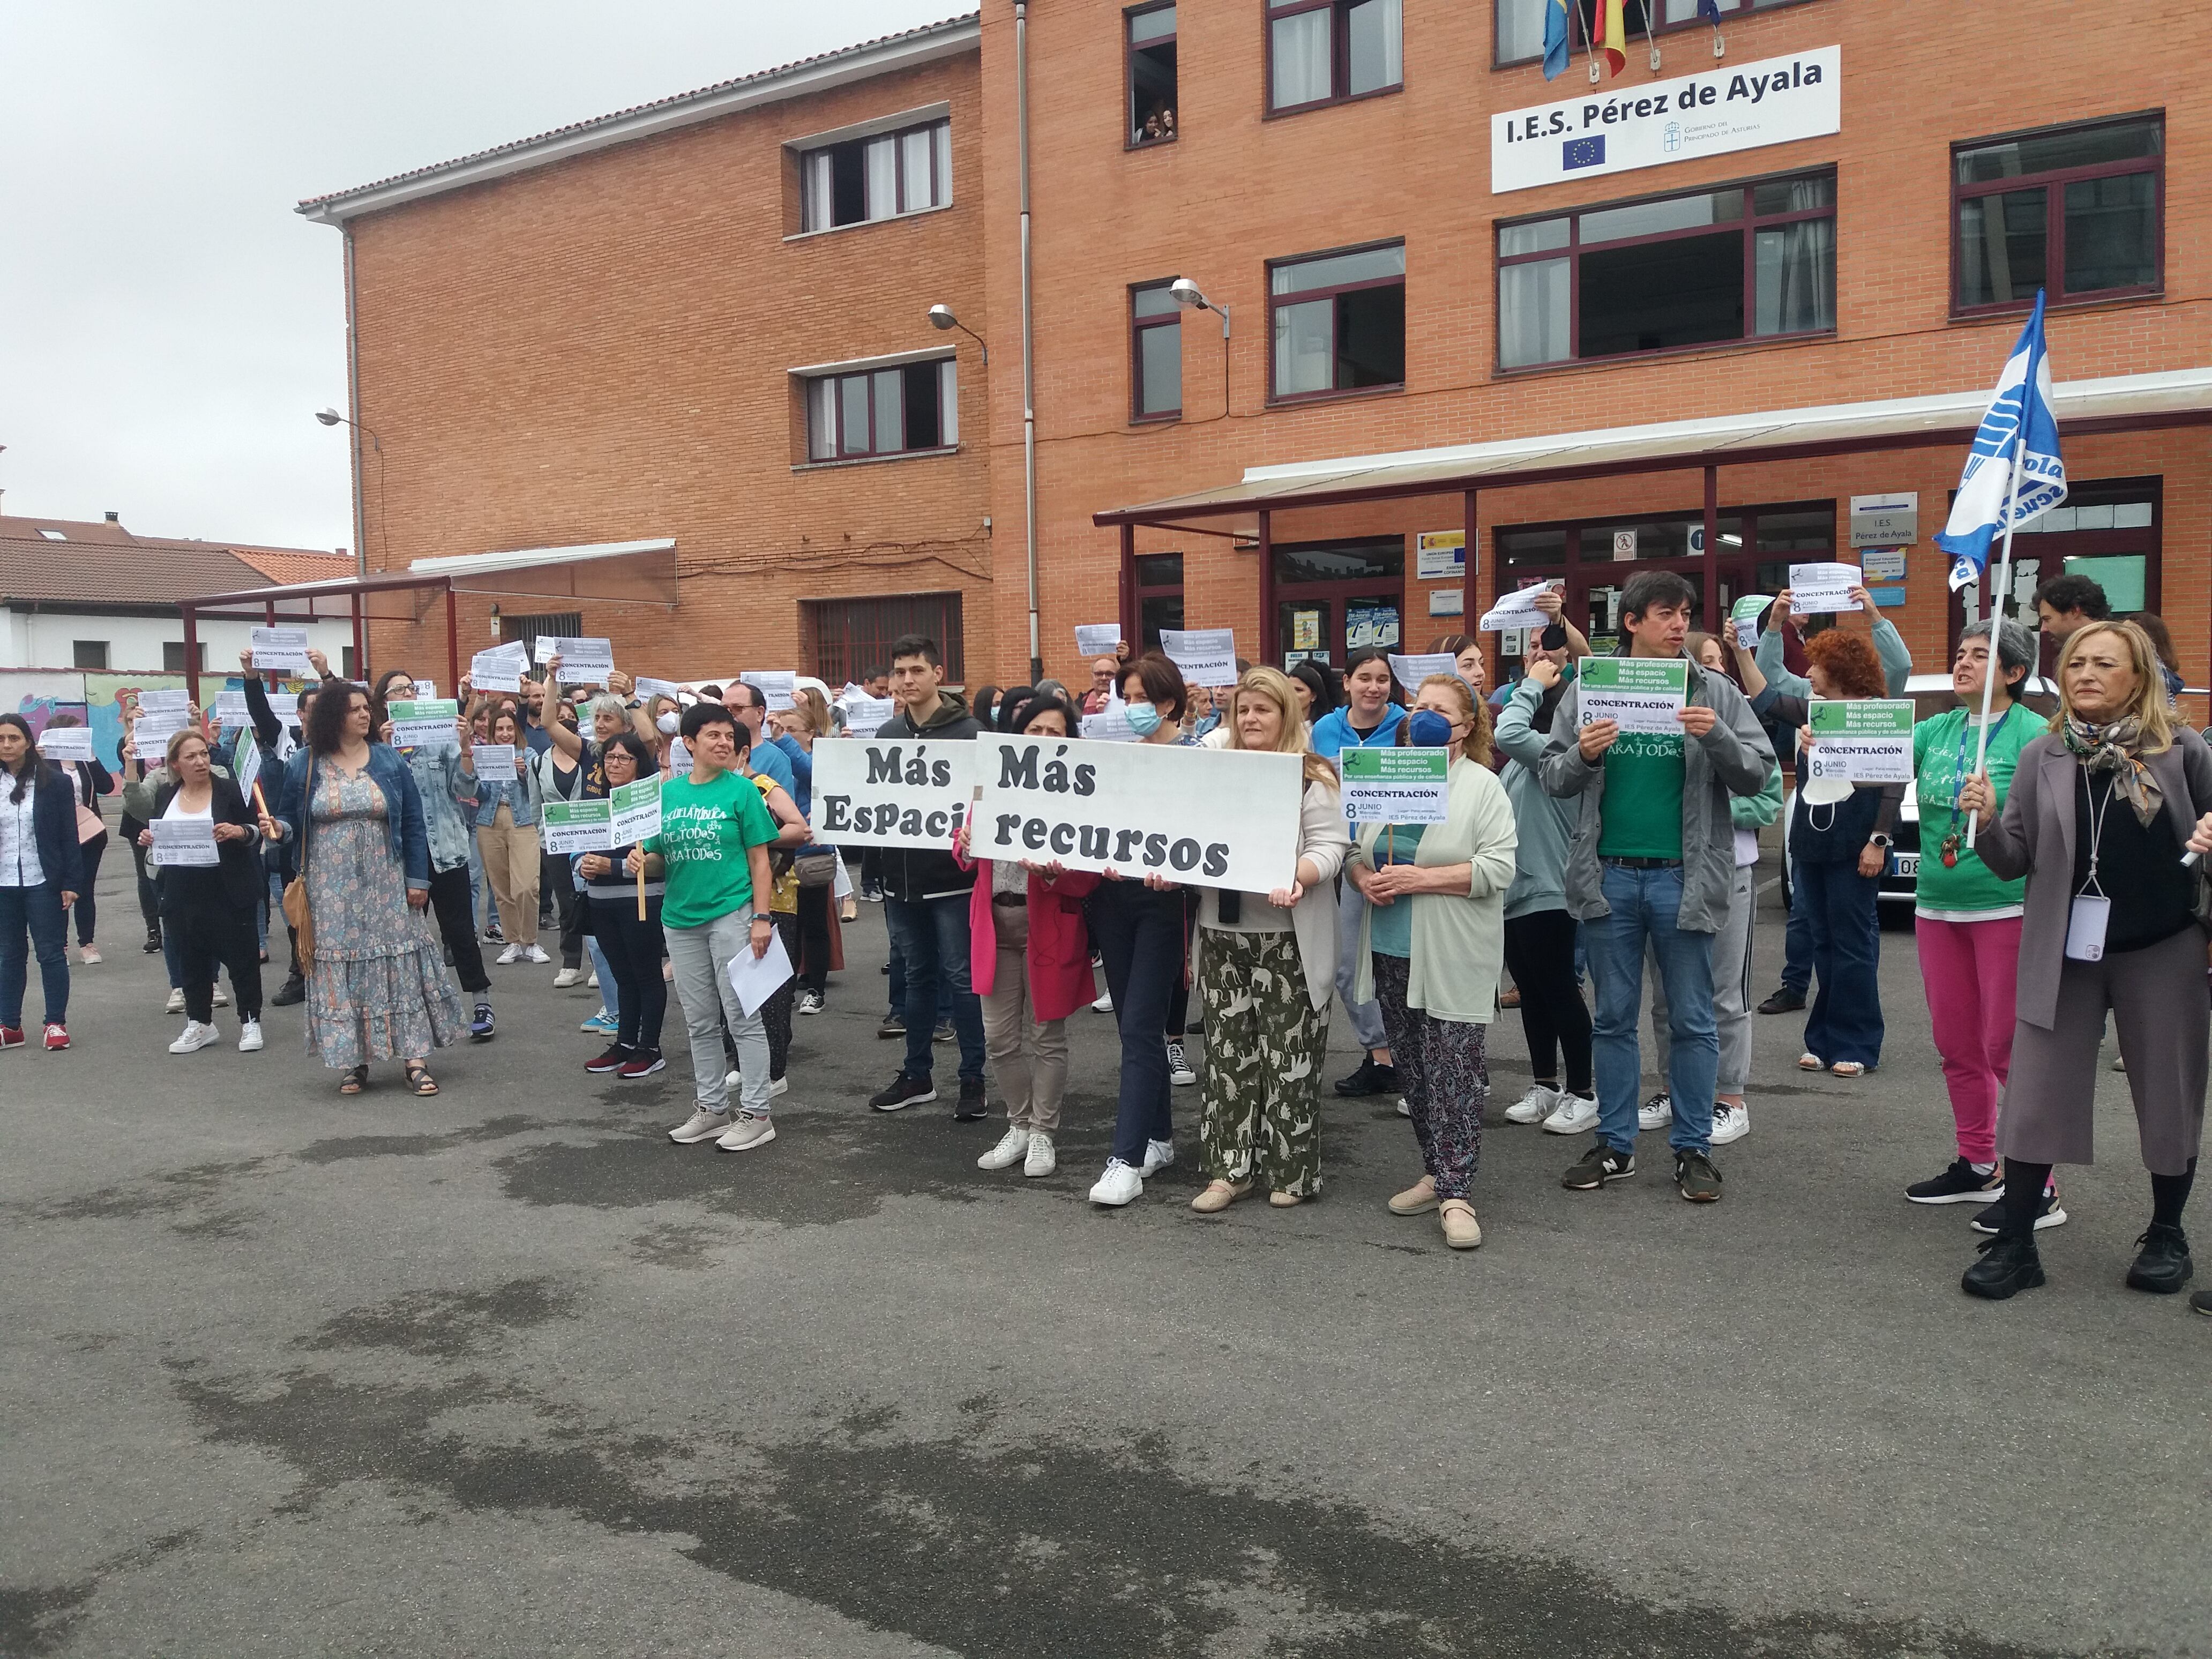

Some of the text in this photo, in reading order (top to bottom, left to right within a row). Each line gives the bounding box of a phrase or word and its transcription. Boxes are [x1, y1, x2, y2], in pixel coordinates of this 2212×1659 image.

[1507, 61, 1822, 144] I.E.S. Pérez de Ayala
[1684, 123, 1716, 133] GOBIERNO
[1684, 132, 1720, 143] PRINCIPADO
[1731, 124, 1760, 133] ASTURIAS
[1874, 519, 1893, 527] I.E.S.
[1856, 532, 1878, 540] Pérez
[1890, 529, 1912, 539] Ayala
[1793, 602, 1800, 612] 8
[1483, 619, 1490, 629] 8
[1739, 636, 1747, 647] 8
[254, 658, 260, 667] 8
[1177, 660, 1228, 669] NCENTRACIÓN
[1636, 660, 1684, 668] profesorado
[558, 671, 565, 681] 8
[1635, 669, 1666, 677] espacio
[1587, 699, 1675, 709] CONCENTRACIÓN
[1863, 702, 1910, 711] profesorado
[1582, 711, 1593, 726] 8
[1863, 712, 1893, 720] espacio
[397, 723, 453, 732] CONCENTRACIÓN
[394, 735, 402, 745] 8
[1398, 749, 1445, 757] profesorado
[1607, 743, 1634, 754] ARA
[1819, 745, 1903, 754] CONCENTRACIÓN
[865, 745, 951, 787] Más
[998, 744, 1096, 796] Más
[1813, 760, 1823, 776] 8
[1350, 789, 1438, 798] CONCENTRACIÓN
[662, 805, 727, 823] ESCUELA PÚBLICA
[1346, 803, 1357, 819] 8
[617, 808, 657, 827] CONCENTRACIÓN
[823, 795, 965, 838] Espaci
[552, 827, 607, 837] CONCENTRACIÓN
[614, 832, 621, 845] 8
[663, 831, 678, 845] DE
[550, 841, 558, 852] 8
[995, 813, 1230, 878] recursos
[156, 853, 163, 863] 8
[664, 850, 684, 865] PARA
